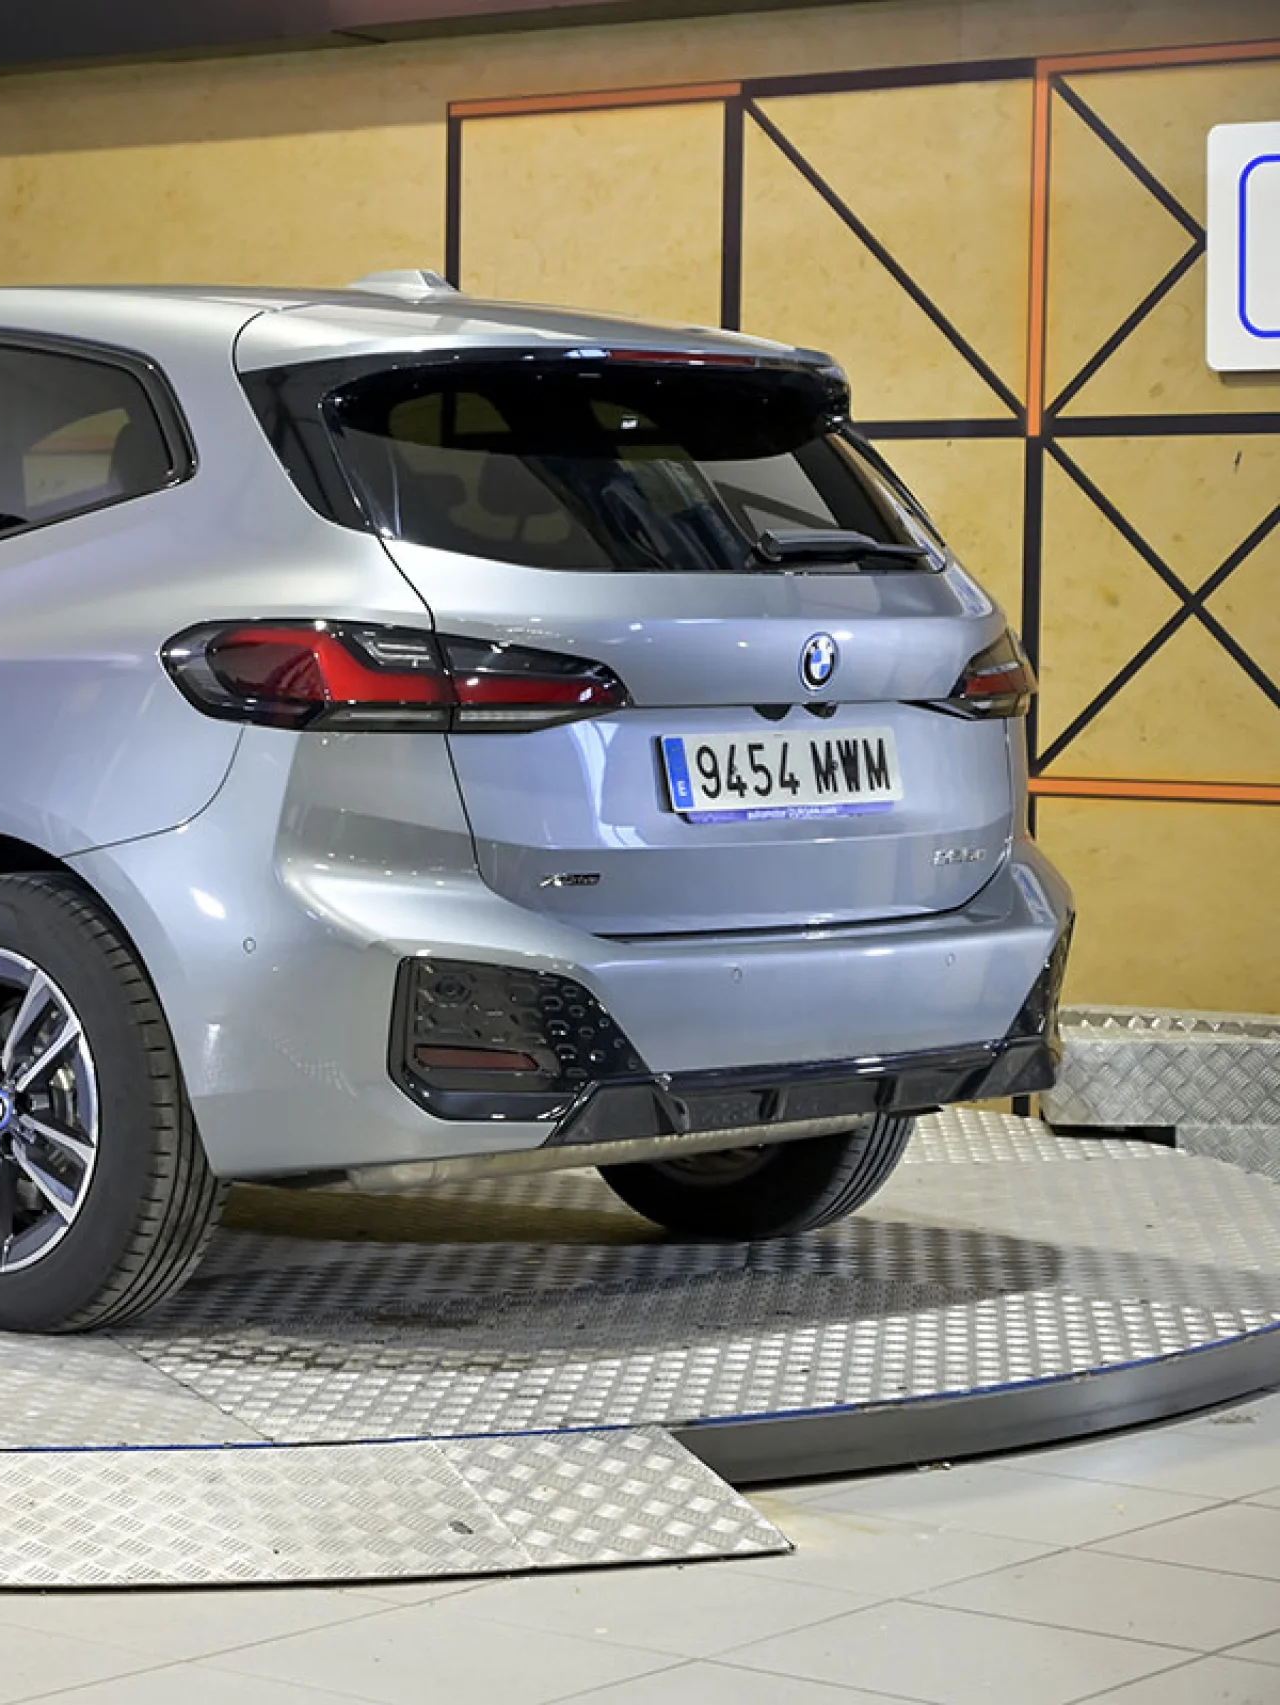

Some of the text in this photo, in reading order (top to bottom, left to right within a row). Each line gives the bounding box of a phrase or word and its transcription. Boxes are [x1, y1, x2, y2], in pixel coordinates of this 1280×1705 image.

[695, 738, 891, 799] 9454 MWM
[677, 781, 687, 797] E
